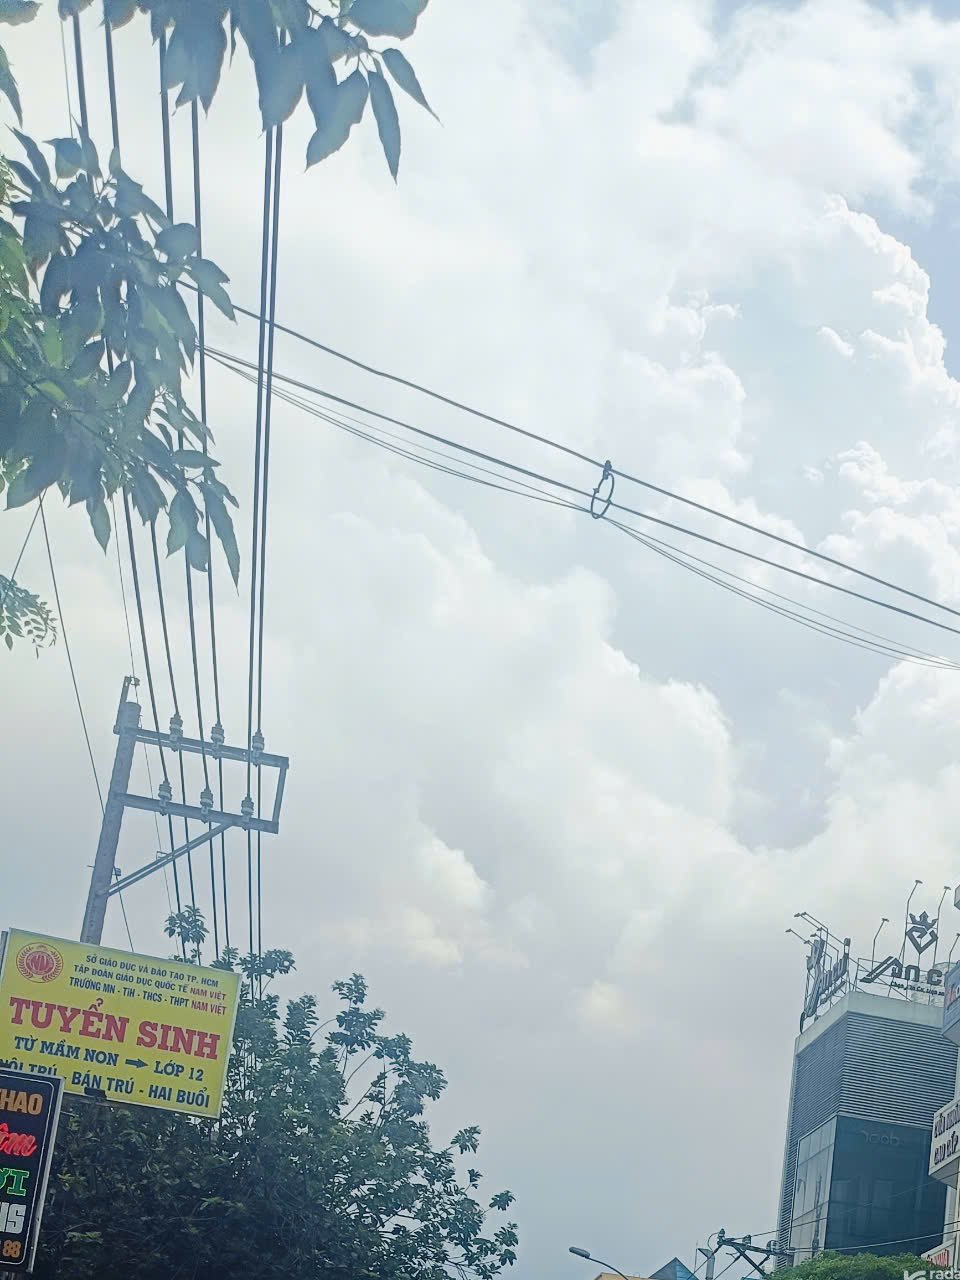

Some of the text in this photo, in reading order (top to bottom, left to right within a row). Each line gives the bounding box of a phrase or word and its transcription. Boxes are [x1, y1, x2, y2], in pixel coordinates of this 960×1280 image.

[86, 954, 98, 963] SỞ
[99, 956, 118, 968] GIÁO
[120, 961, 136, 972] DỤC
[138, 963, 149, 974] VÀ
[187, 974, 199, 984] TP.
[201, 977, 219, 988] HCM
[92, 968, 114, 980] ĐOÀN
[116, 972, 134, 983] GIÁO
[136, 976, 152, 987] DỤC
[155, 979, 176, 992] QUỐC
[190, 987, 207, 997] NAM
[209, 990, 227, 1001] VIỆT
[69, 976, 101, 990] TRƯỜNG
[102, 983, 115, 994] MN
[143, 990, 162, 1002] THCS
[170, 995, 189, 1008] THPT
[191, 999, 208, 1012] NAM
[210, 1003, 227, 1016] VIỆT
[9, 997, 220, 1060] TUYỂN SINH
[14, 1035, 204, 1082] TỪ MẦM NON LỚP 12
[72, 1070, 100, 1089] BÁN
[106, 1076, 135, 1095] TRÚ
[148, 1084, 172, 1101] HAI
[176, 1086, 210, 1108] BUỔI
